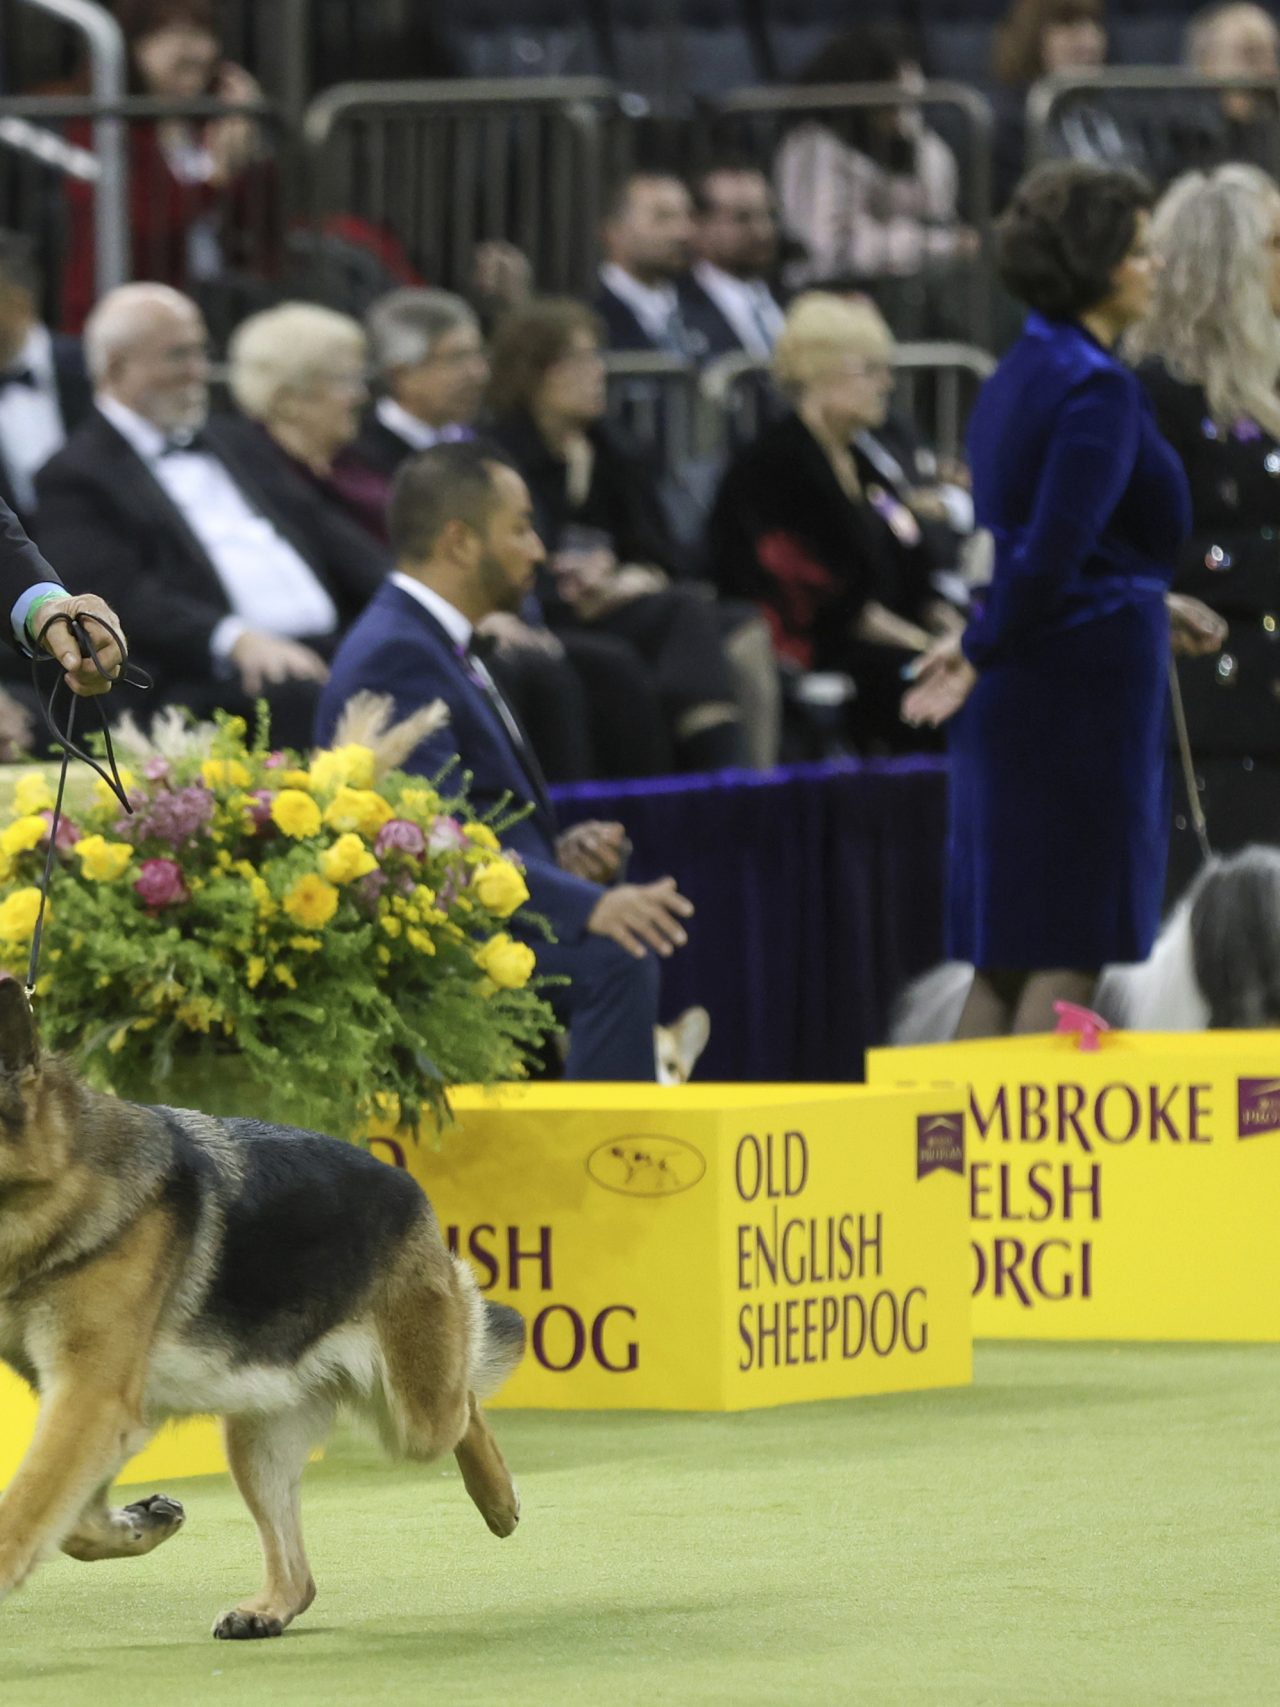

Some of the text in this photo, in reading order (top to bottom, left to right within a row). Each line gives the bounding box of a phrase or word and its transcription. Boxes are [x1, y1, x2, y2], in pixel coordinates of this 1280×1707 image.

[969, 1081, 1213, 1154] MBROKE
[735, 1131, 809, 1203] OLD
[970, 1161, 1102, 1222] ELSH
[737, 1206, 883, 1290] ENGLISH
[738, 1285, 929, 1372] SHEEPDOG
